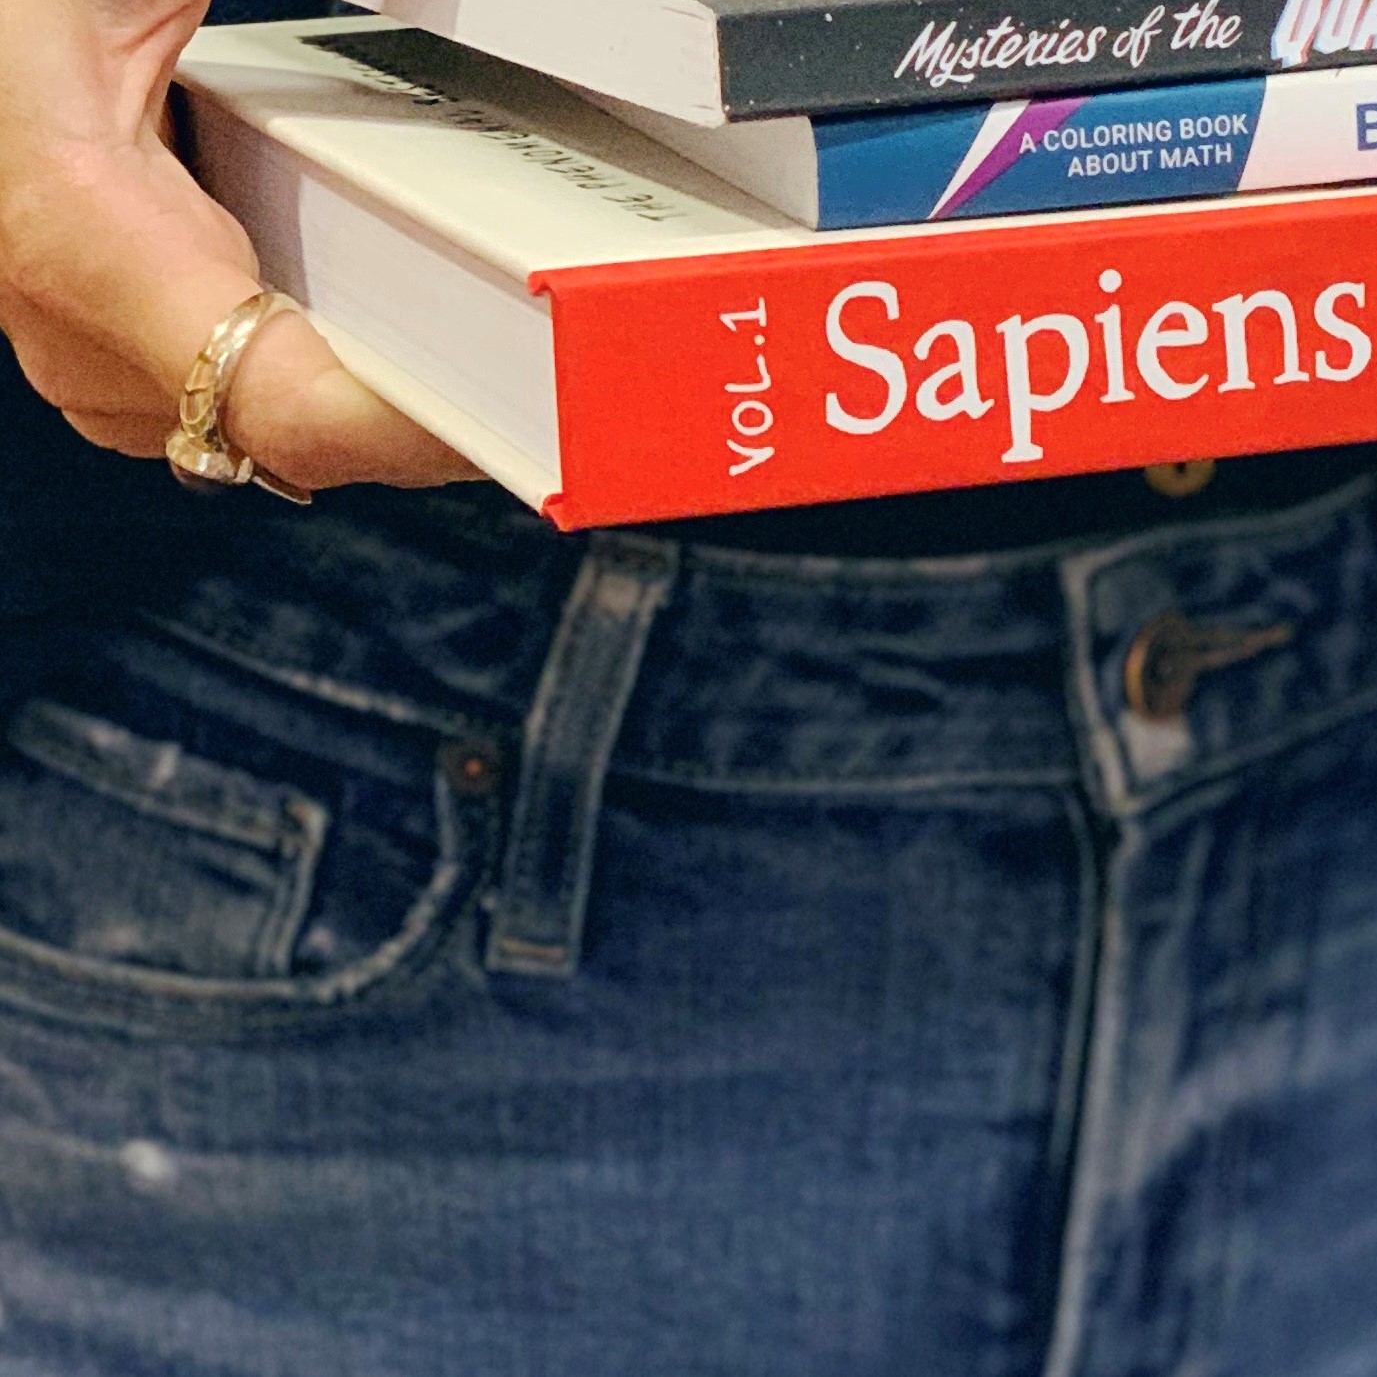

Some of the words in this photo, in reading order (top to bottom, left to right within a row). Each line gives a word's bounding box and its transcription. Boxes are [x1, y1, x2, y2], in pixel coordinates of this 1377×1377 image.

[894, 17, 1107, 87] Mysteries
[1112, 4, 1163, 68] of
[1019, 131, 1038, 154] A
[1042, 119, 1173, 153] COLORING
[1179, 113, 1249, 138] BOOK
[1067, 150, 1154, 179] ABOUT
[1160, 142, 1233, 169] MATH
[825, 268, 1373, 465] Sapiens
